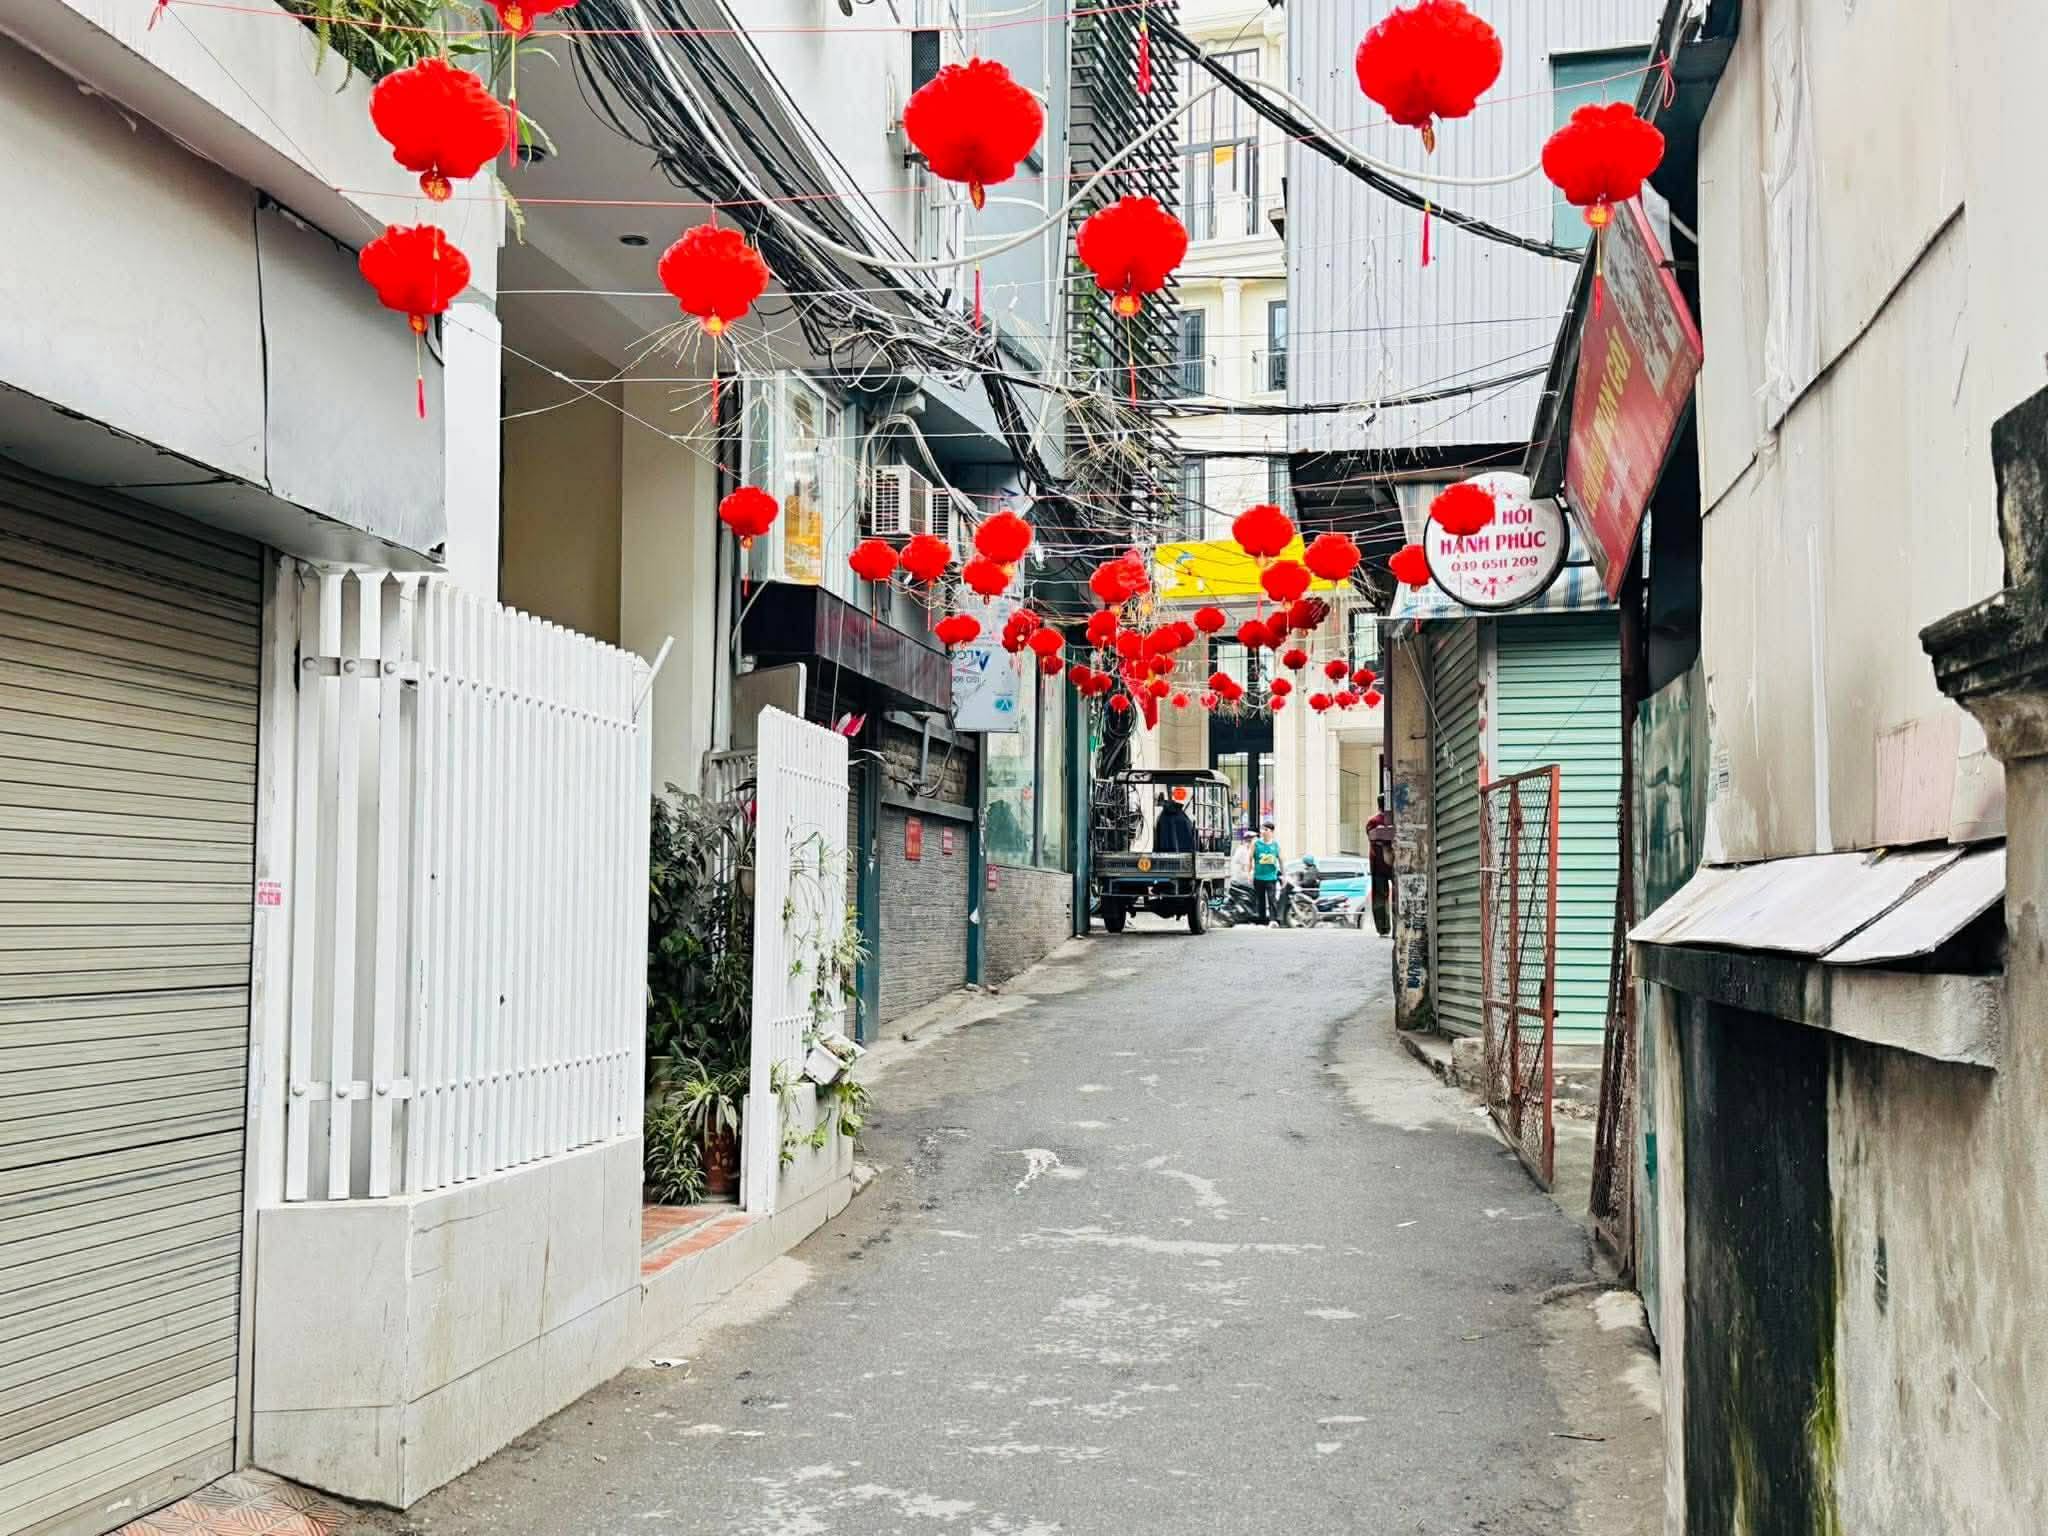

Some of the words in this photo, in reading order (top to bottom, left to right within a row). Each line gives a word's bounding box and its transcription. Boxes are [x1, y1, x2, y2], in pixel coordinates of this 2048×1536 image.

[1497, 526, 1546, 551] PHÚC
[1451, 559, 1477, 572] 039
[1512, 556, 1538, 568] 209
